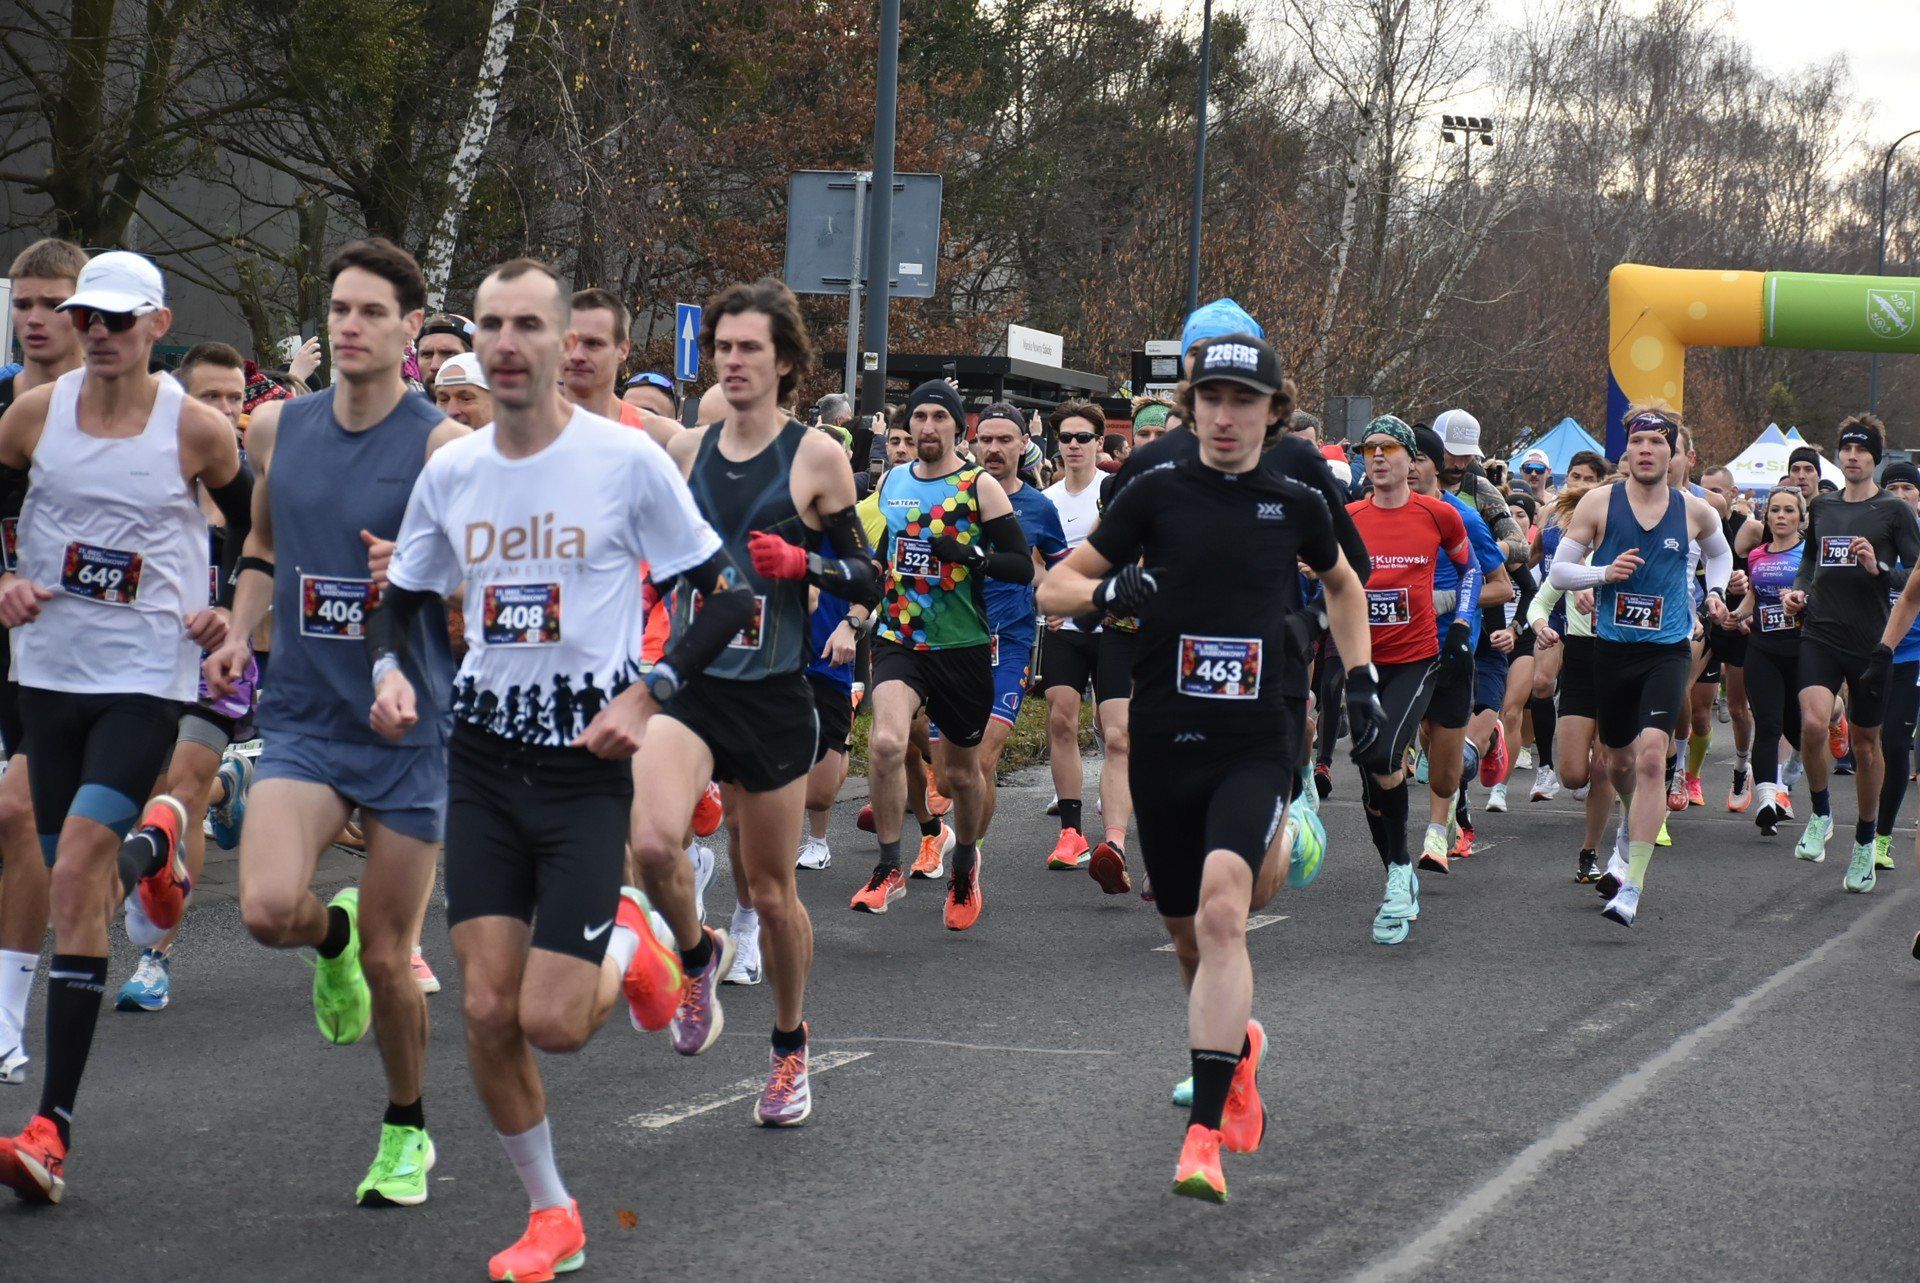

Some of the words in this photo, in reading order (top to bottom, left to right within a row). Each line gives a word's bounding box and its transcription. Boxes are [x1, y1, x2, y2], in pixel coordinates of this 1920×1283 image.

[1205, 344, 1259, 365] 226ERS
[465, 513, 586, 564] Delia
[904, 552, 930, 567] 522
[1376, 555, 1429, 565] Kurowski
[1829, 547, 1849, 558] 780
[78, 564, 122, 589] 649
[318, 600, 363, 622] 406
[497, 605, 544, 629] 408
[1371, 603, 1397, 616] 531
[1627, 606, 1652, 620] 779
[1767, 614, 1786, 624] 311
[1196, 660, 1242, 682] 463
